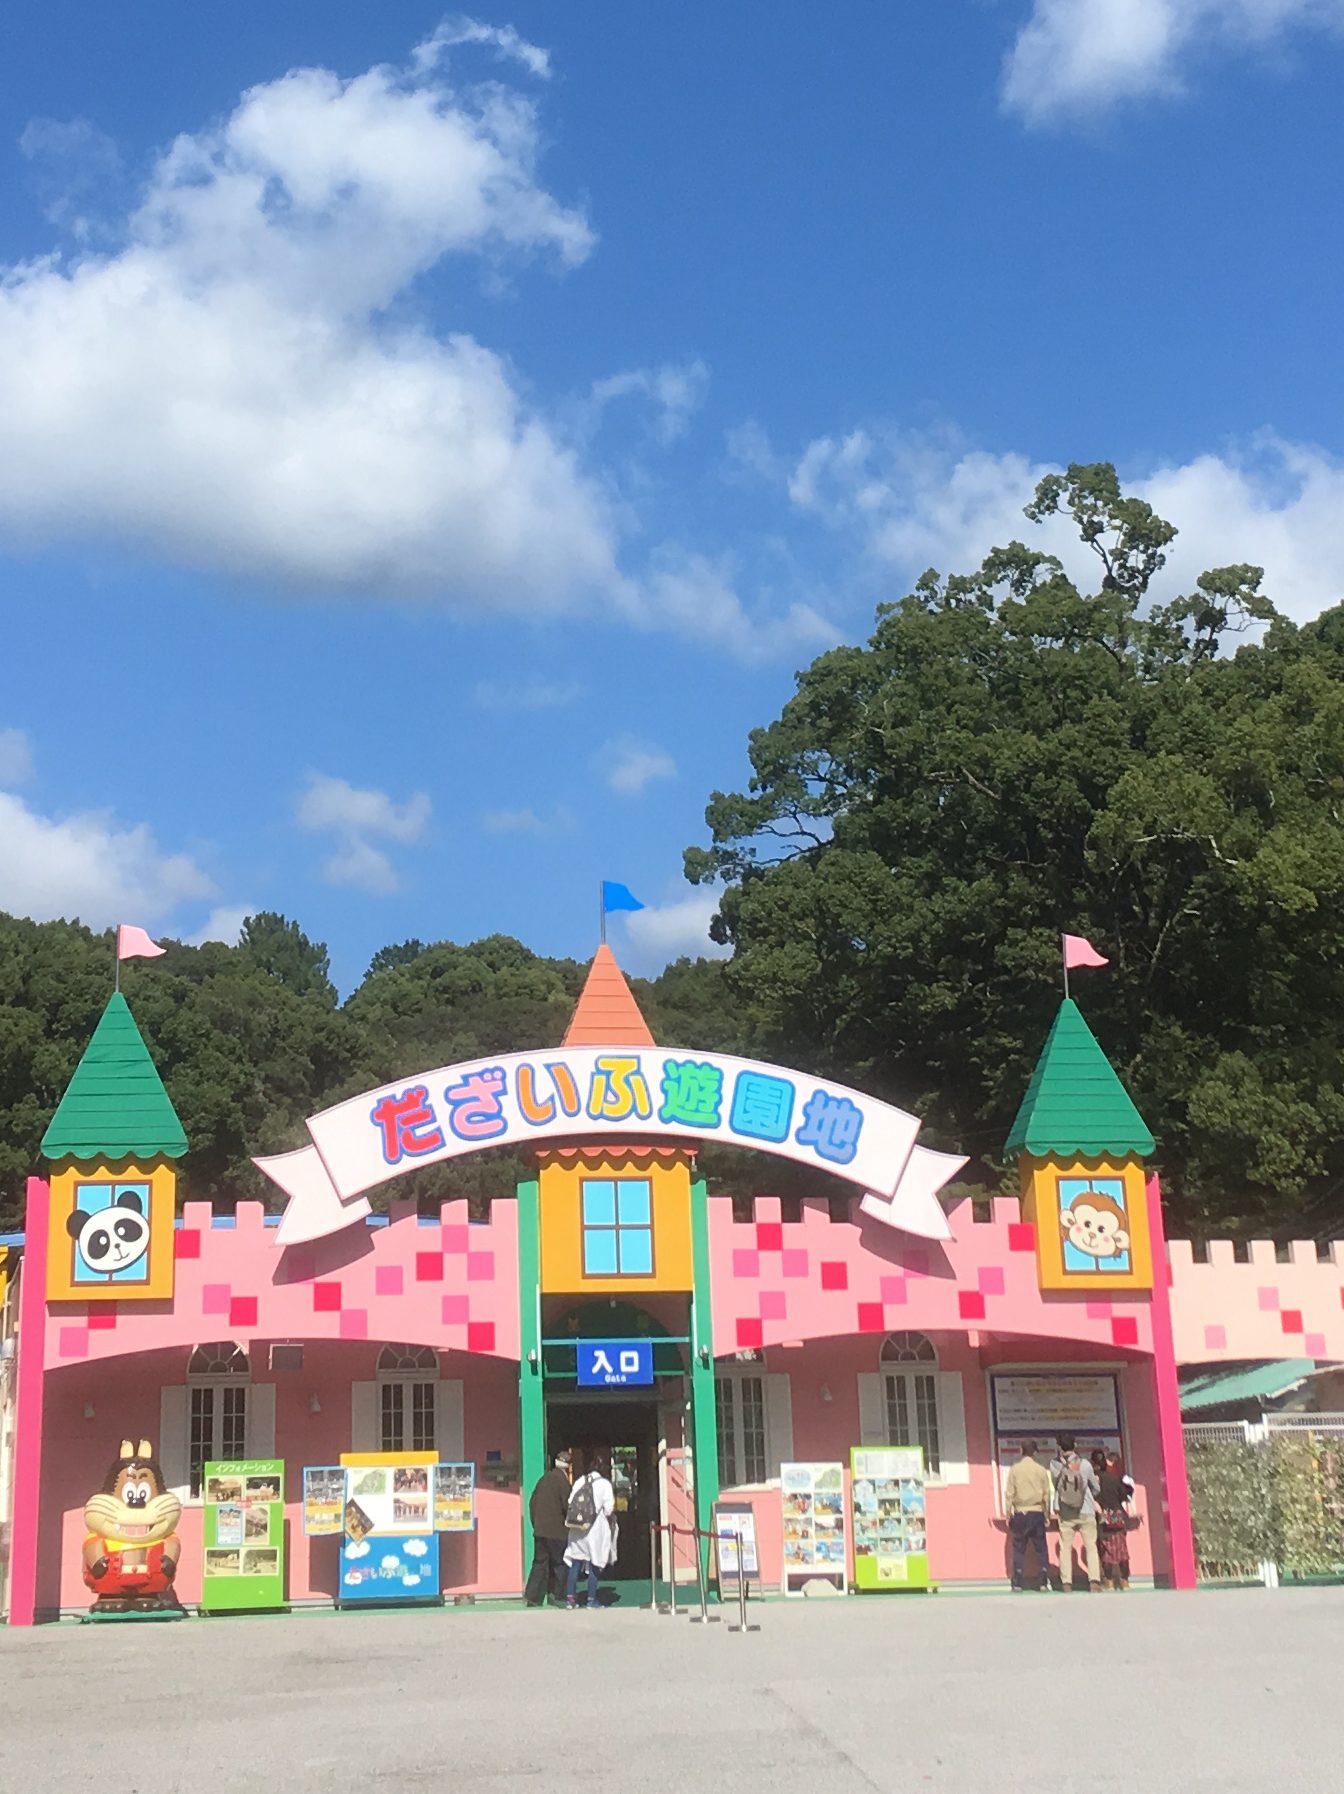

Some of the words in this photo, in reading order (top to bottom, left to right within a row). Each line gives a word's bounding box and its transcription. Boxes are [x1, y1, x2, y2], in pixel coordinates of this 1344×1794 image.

[370, 1054, 864, 1165] だざいふ遊園地
[591, 1349, 639, 1374] 入口
